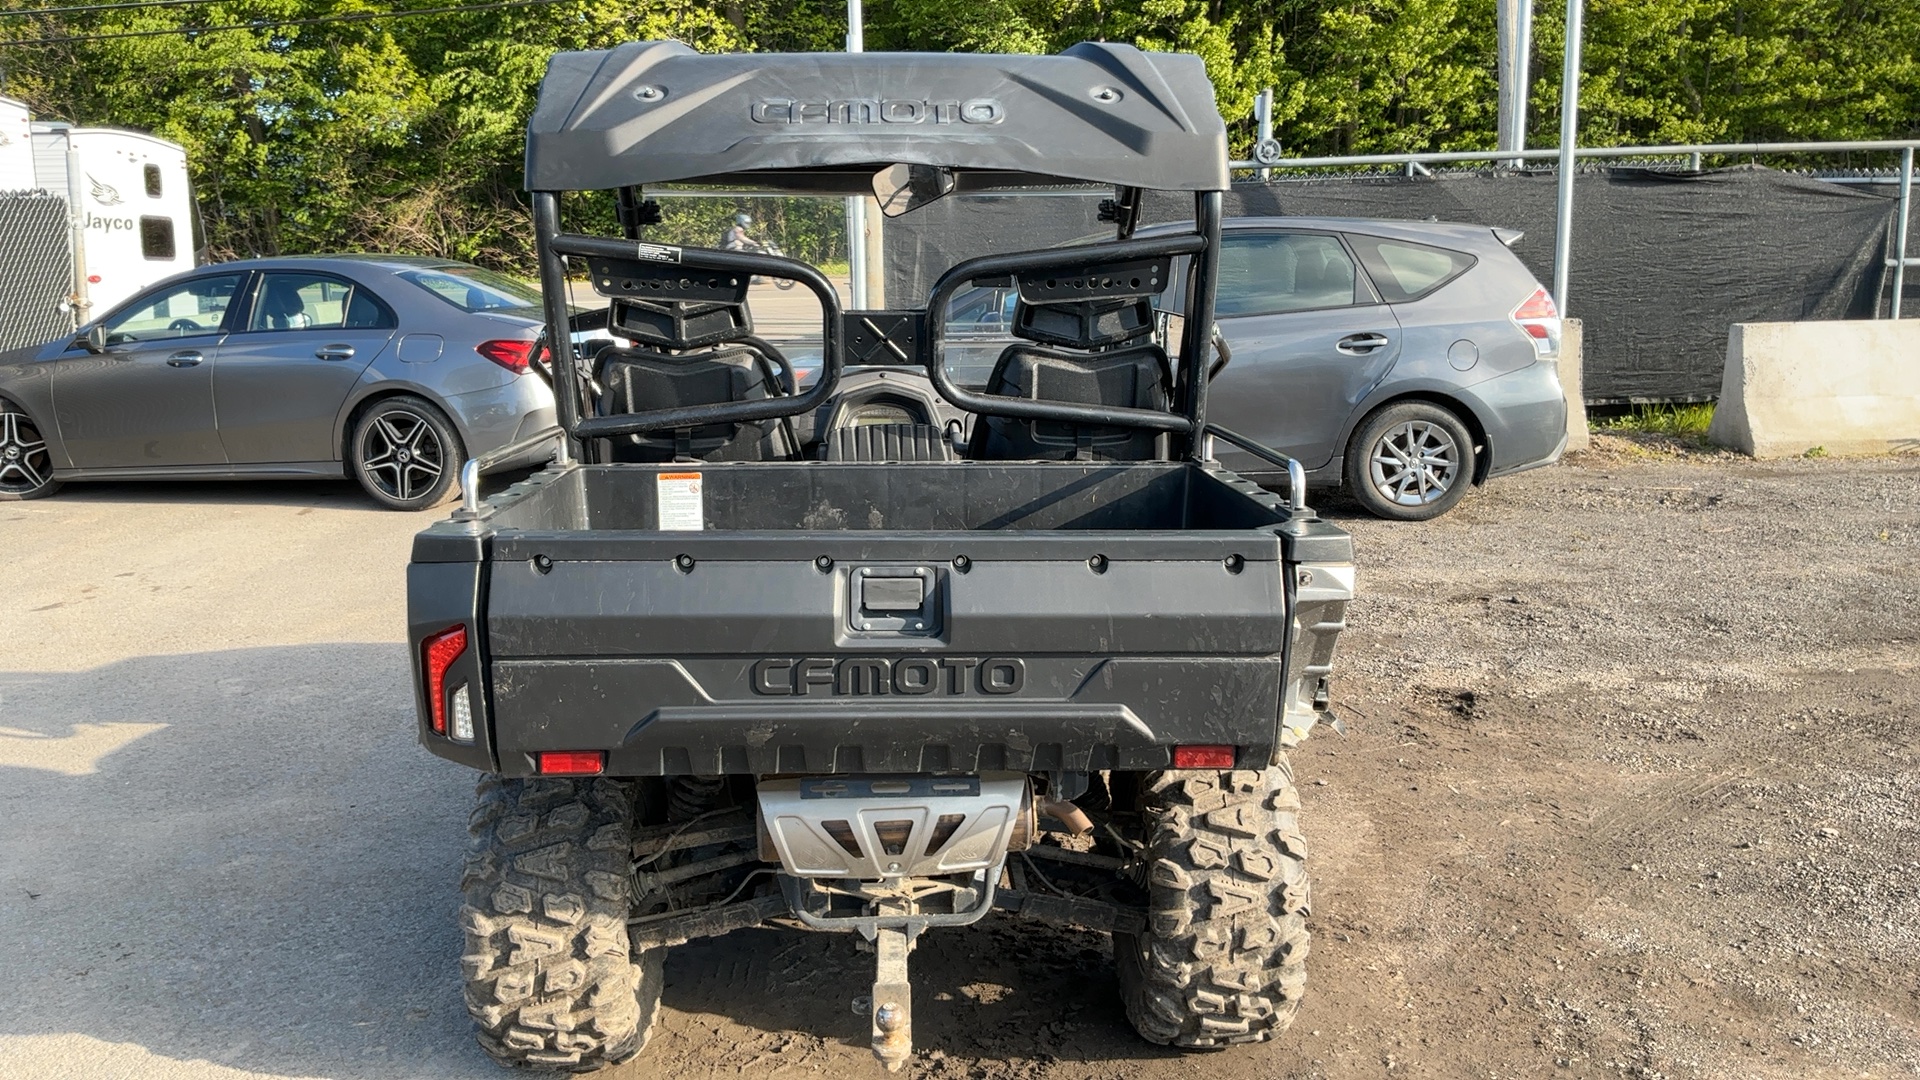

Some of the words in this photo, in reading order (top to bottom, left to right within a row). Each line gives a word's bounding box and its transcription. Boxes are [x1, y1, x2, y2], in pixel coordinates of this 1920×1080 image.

[751, 99, 1005, 125] CFMOTO
[84, 211, 133, 234] Jayco
[753, 657, 1025, 695] CFMOTO
